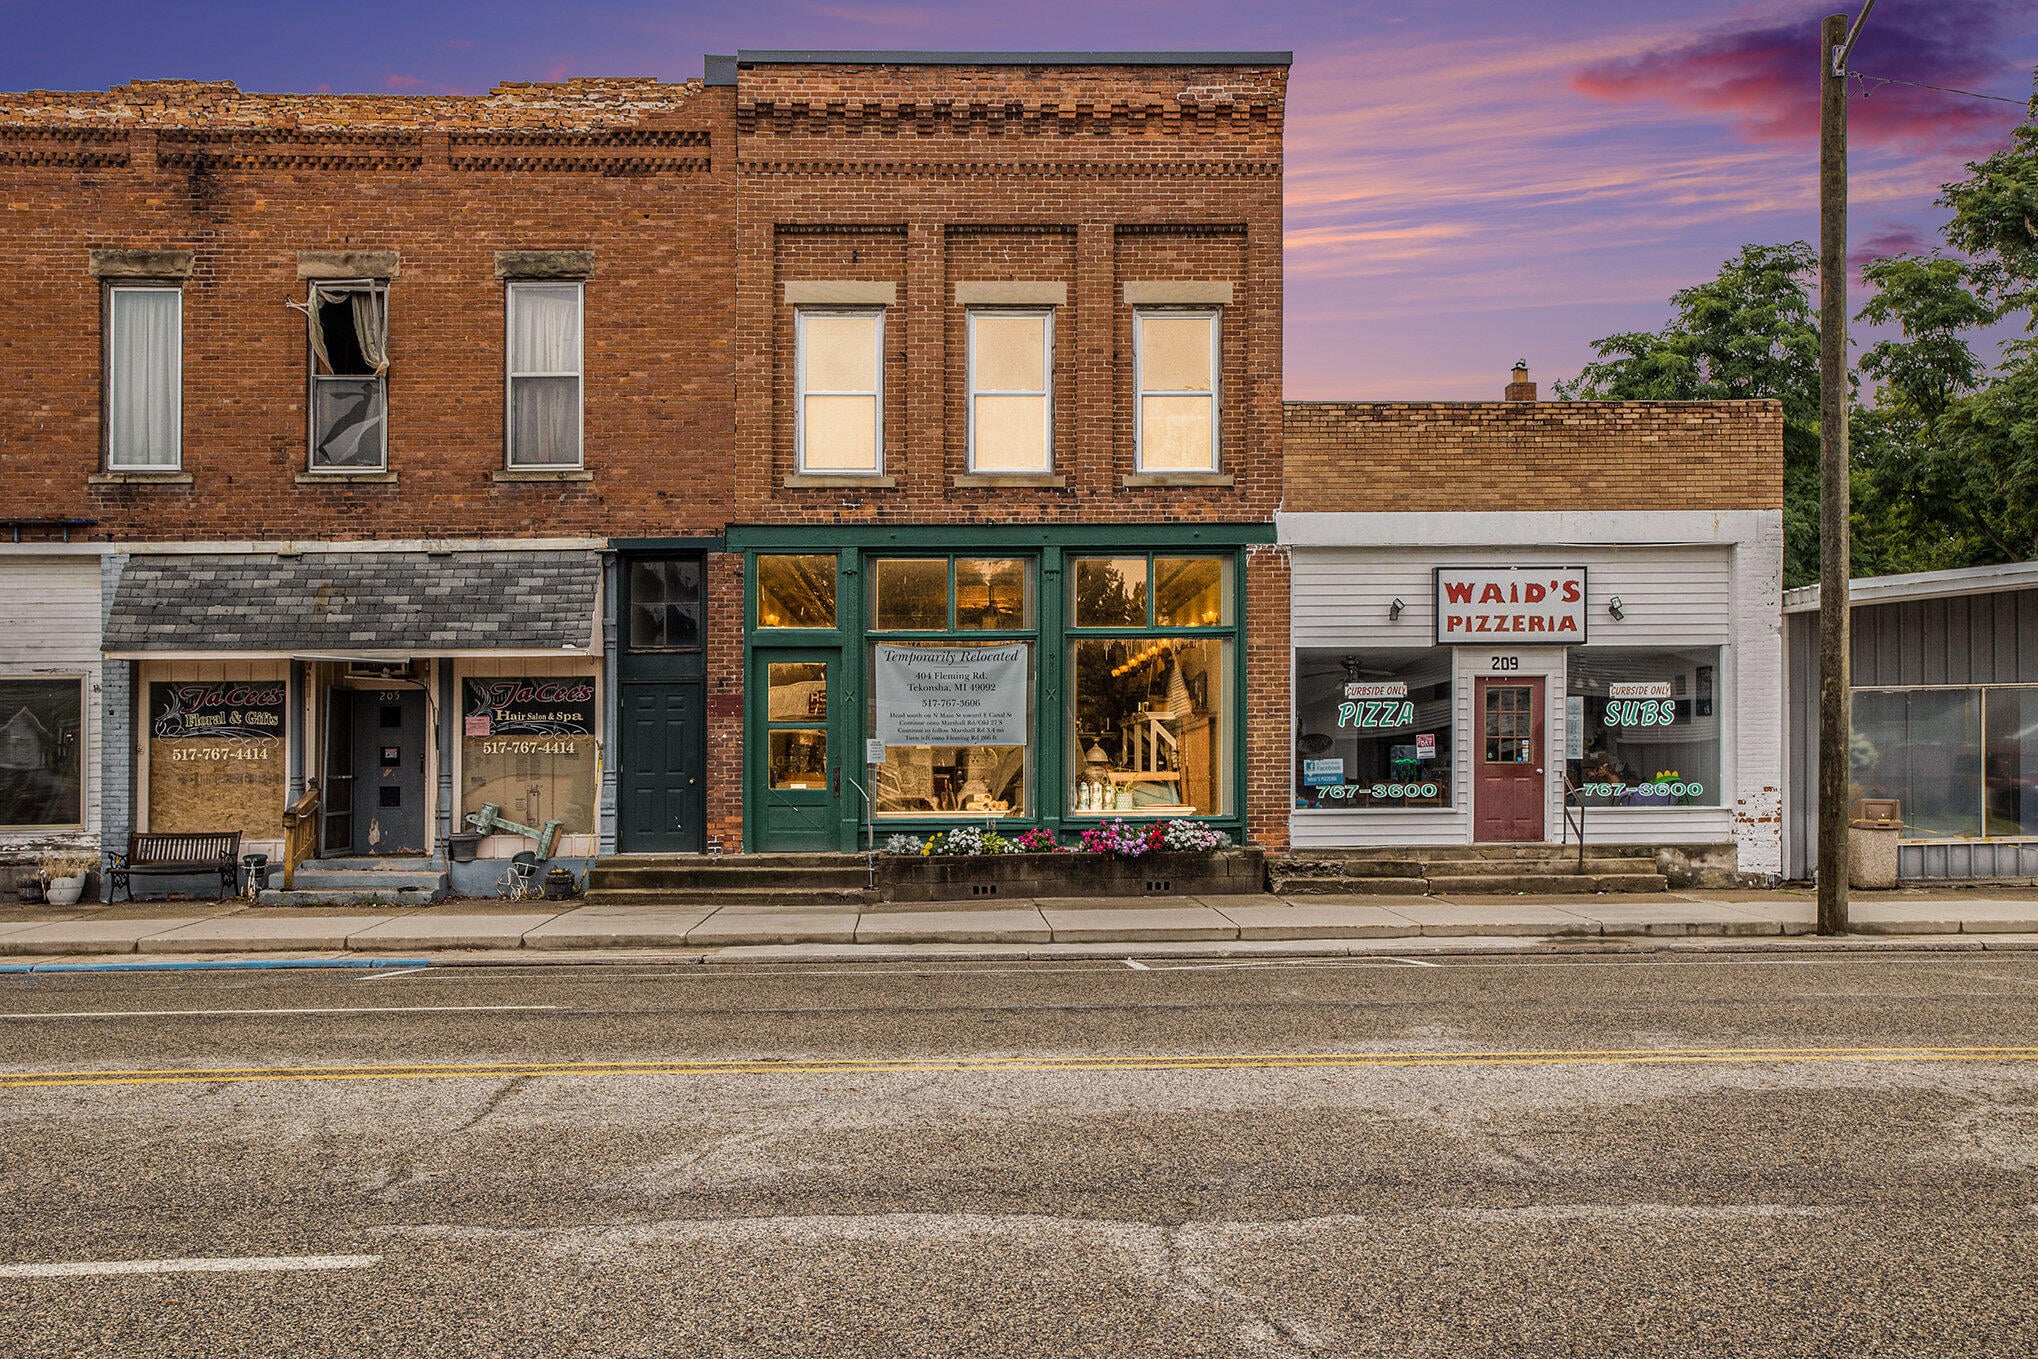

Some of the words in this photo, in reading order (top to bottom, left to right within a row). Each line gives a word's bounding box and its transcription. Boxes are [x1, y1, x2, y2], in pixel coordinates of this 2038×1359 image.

[1443, 579, 1581, 604] WAID'S
[1446, 615, 1577, 632] PIZZERIA
[884, 650, 956, 666] Temporarily
[961, 650, 1019, 661] Relocated
[1492, 656, 1518, 670] 209
[934, 672, 970, 681] Fleming
[973, 672, 987, 680] Rd.
[907, 683, 952, 692] Tekonsha,
[969, 683, 996, 692] 49092
[1346, 685, 1384, 696] CURBSIDE
[1387, 685, 1406, 695] ONLY
[1611, 685, 1648, 695] CURBSIDE
[1651, 685, 1671, 695] ONLY
[380, 691, 400, 700] 205
[922, 699, 981, 707] 517-767-3606
[184, 711, 226, 727] Floral
[229, 710, 241, 724] &
[245, 711, 278, 726] Gifts
[495, 709, 526, 720] Hair
[527, 712, 546, 720] Salon
[547, 712, 555, 721] &
[556, 711, 583, 722] Spa
[1338, 701, 1414, 728] PIZZA
[1604, 700, 1675, 726] SUBS
[172, 748, 268, 760] 517-767-4414
[483, 742, 575, 754] 517-767-4414
[1316, 784, 1437, 799] 767-3600
[1583, 783, 1703, 796] 767-3600
